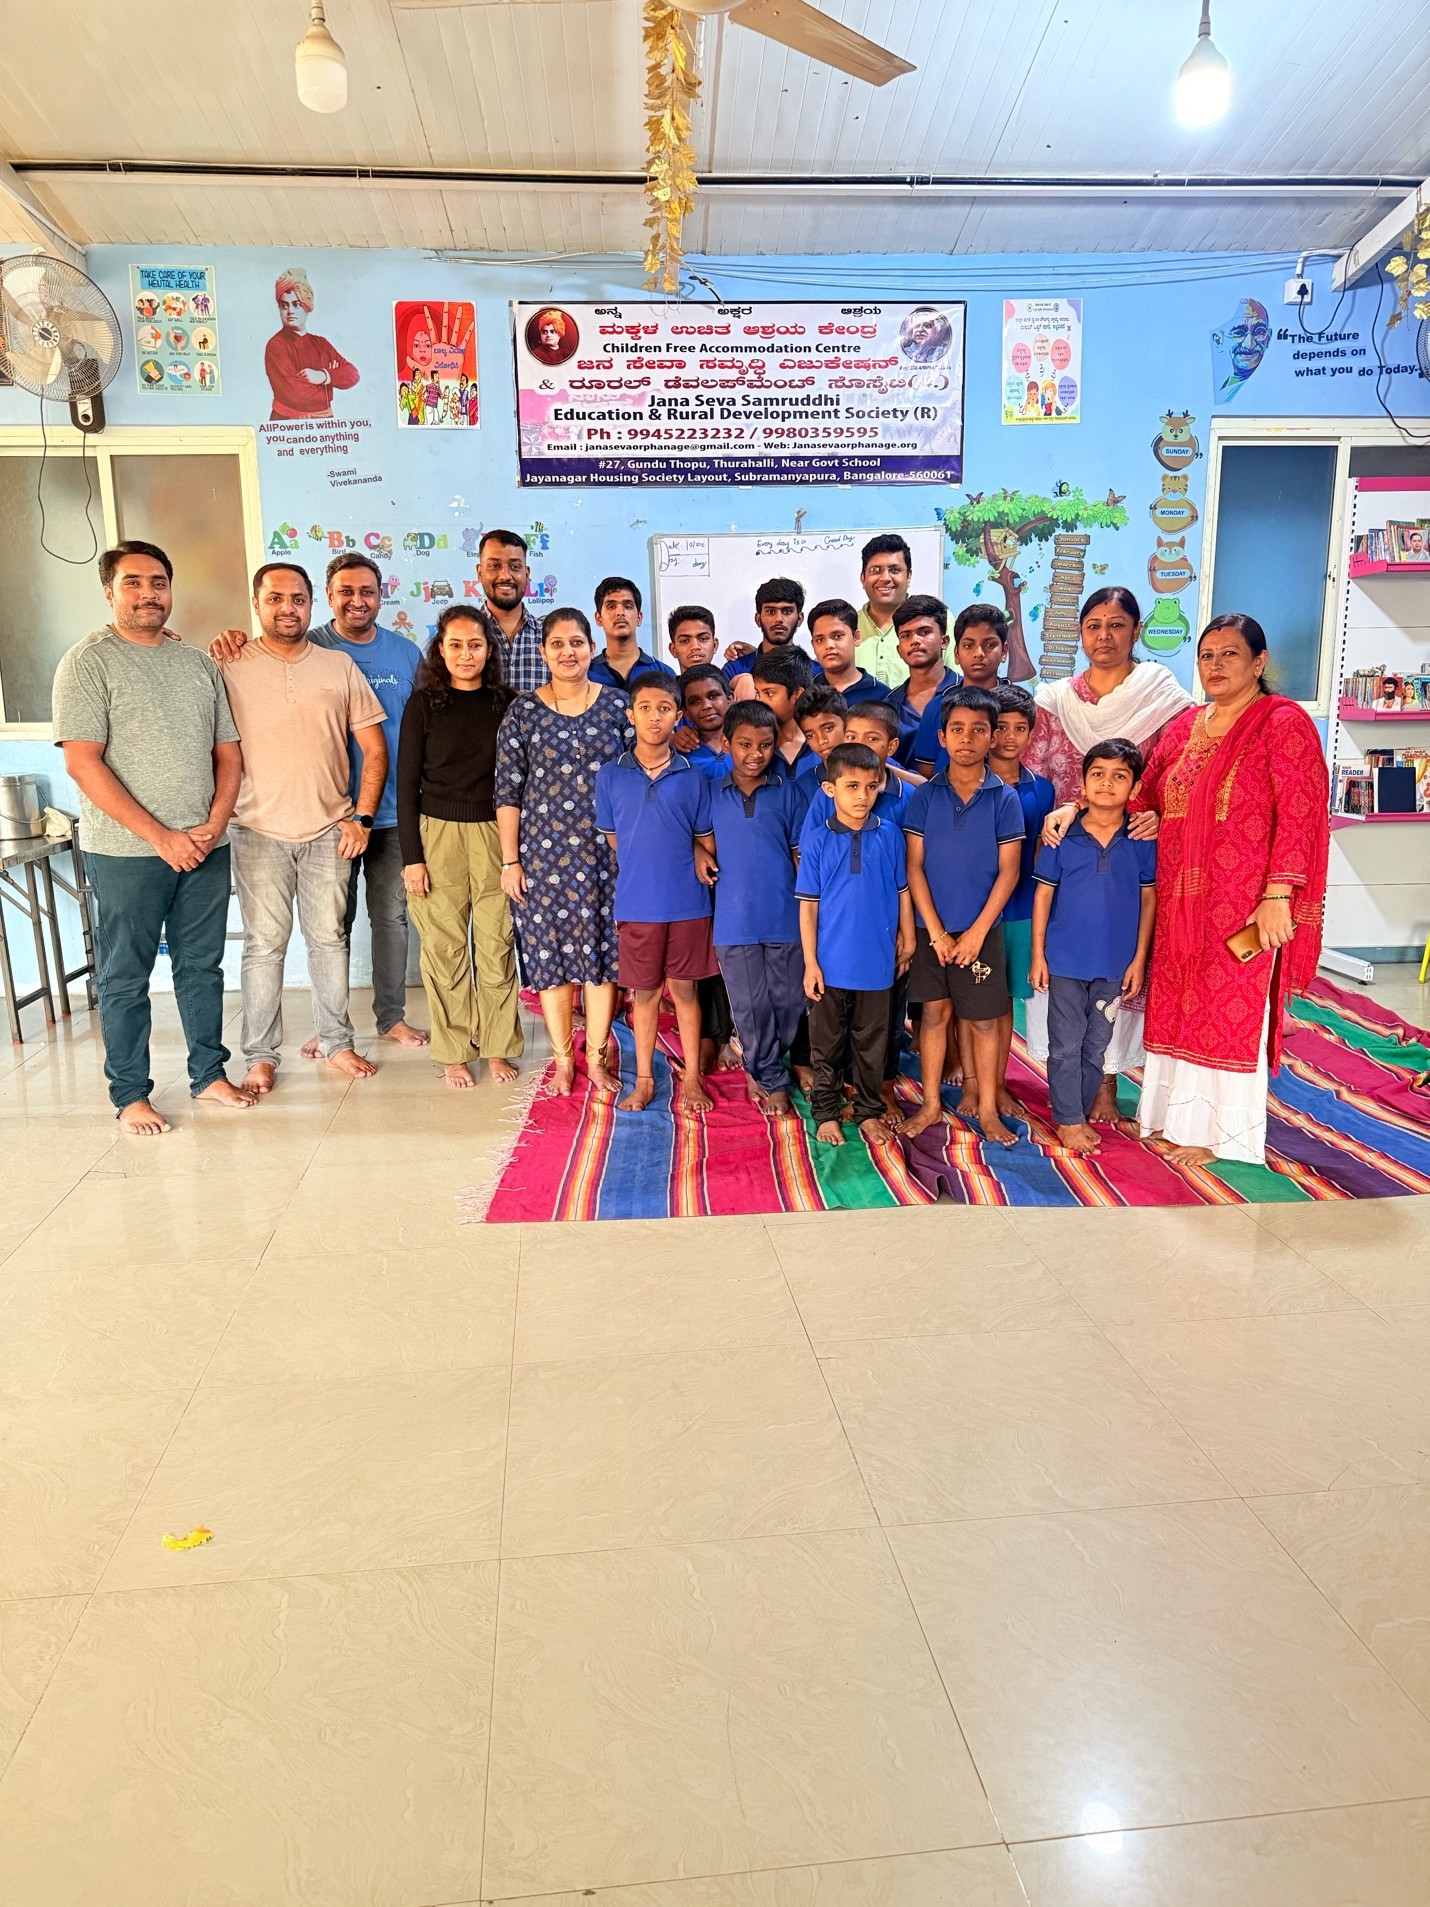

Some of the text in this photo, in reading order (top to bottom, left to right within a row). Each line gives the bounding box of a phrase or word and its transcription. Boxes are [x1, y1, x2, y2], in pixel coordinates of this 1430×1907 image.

[141, 270, 206, 280] TAKE CARE OF YOUR
[148, 280, 200, 289] MENTAL HEALTH
[595, 305, 881, 319] ಅನ್ನ ಅಕ್ಷರ ಆಶ್ರಯ
[599, 322, 877, 340] ಮಕ್ಕಳ ಉಚಿತ ಆಶ್ರಯ ಕೇಂದ್ರ
[1318, 332, 1360, 342] Future
[603, 343, 861, 353] Children Free Accommodation Centre
[1293, 347, 1366, 361] depends on
[577, 357, 614, 370] ಜನ
[626, 356, 687, 370] ಸೇವಾ
[1294, 366, 1326, 377] what
[1330, 366, 1353, 377] you
[1358, 367, 1373, 377] do
[539, 379, 555, 390] &
[569, 376, 651, 390] ರೂರಲ್
[648, 394, 840, 407] Jana Seva Samruddhi
[554, 406, 938, 422] Education & Rural Development Society (R)
[316, 420, 347, 429] within
[350, 420, 372, 429] you,
[266, 435, 285, 444] you
[319, 432, 360, 444] anything
[587, 428, 611, 440] Ph
[627, 427, 745, 439] 9945223232
[750, 427, 758, 439] /
[762, 427, 879, 438] 9980359595
[277, 444, 348, 457] and everything
[585, 443, 755, 452] janasevaorphanage@gmail.com
[763, 442, 790, 450] Web:
[792, 442, 918, 451] Janasevaorphanage.org
[599, 458, 881, 471] #27, Gundu Thopu, Thurahalli, Near Govt School
[330, 475, 383, 487] Vivekananda
[525, 471, 950, 485] Jayanagar Housing Society Layout, Subramanyapura, Bangalore-560061
[268, 531, 299, 549] Aa
[327, 531, 356, 548] Bb
[364, 532, 392, 549] Cc
[417, 532, 449, 549] Dd
[1057, 548, 1084, 556] February
[410, 581, 431, 602] Jj
